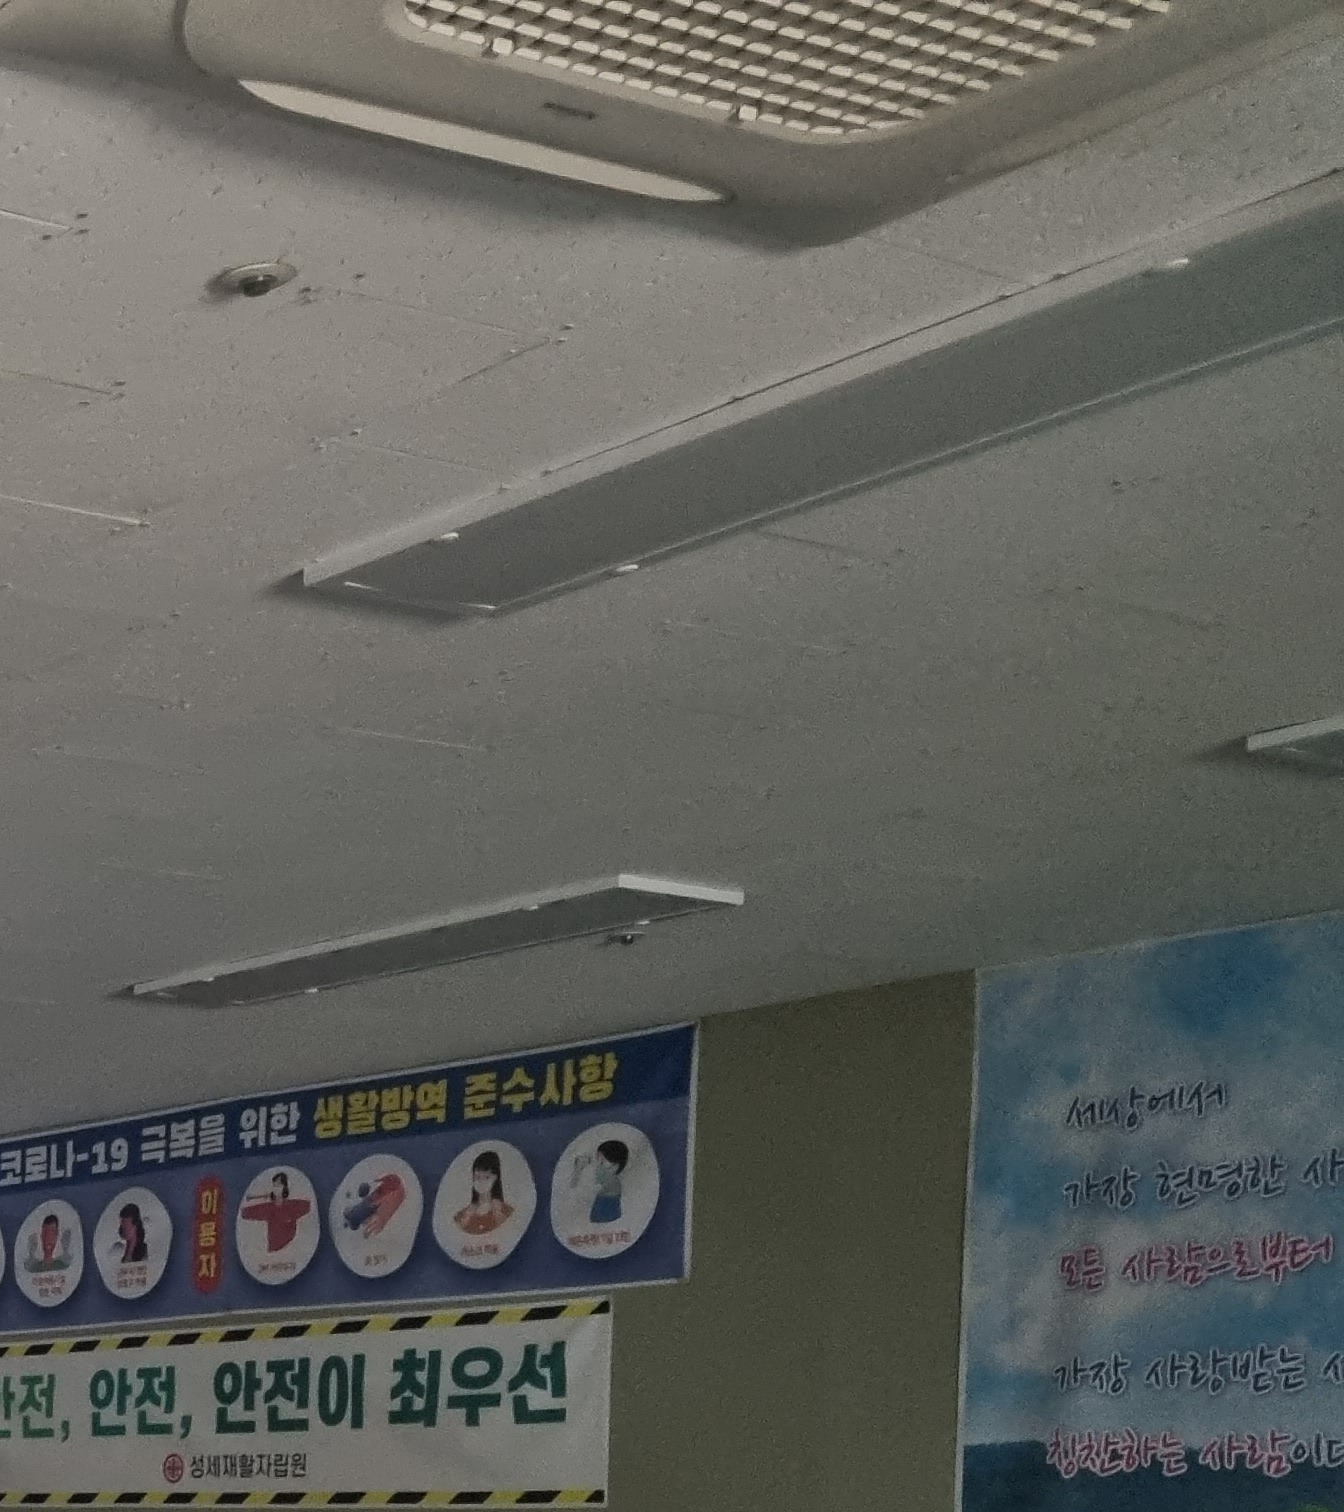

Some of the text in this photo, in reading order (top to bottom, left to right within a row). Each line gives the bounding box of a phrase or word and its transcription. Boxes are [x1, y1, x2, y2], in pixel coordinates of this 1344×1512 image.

[0, 1051, 618, 1187] 코로나-19 극복을 위한 생활방역 준수사항
[1066, 1081, 1227, 1130] 세상에서
[1064, 1165, 1140, 1208] 가장
[1156, 1155, 1287, 1209] 현명한
[198, 1188, 218, 1278] 이용자
[1060, 1231, 1335, 1290] 모든 사람으로부터
[89, 1365, 192, 1440] 안전,
[213, 1352, 366, 1434] 안전이
[388, 1340, 567, 1428] 최우선
[1054, 1352, 1131, 1395] 가장
[1145, 1343, 1305, 1395] 사랑받는
[189, 1452, 307, 1479] 성세재활자립원
[1047, 1428, 1188, 1478] 칭찬하는
